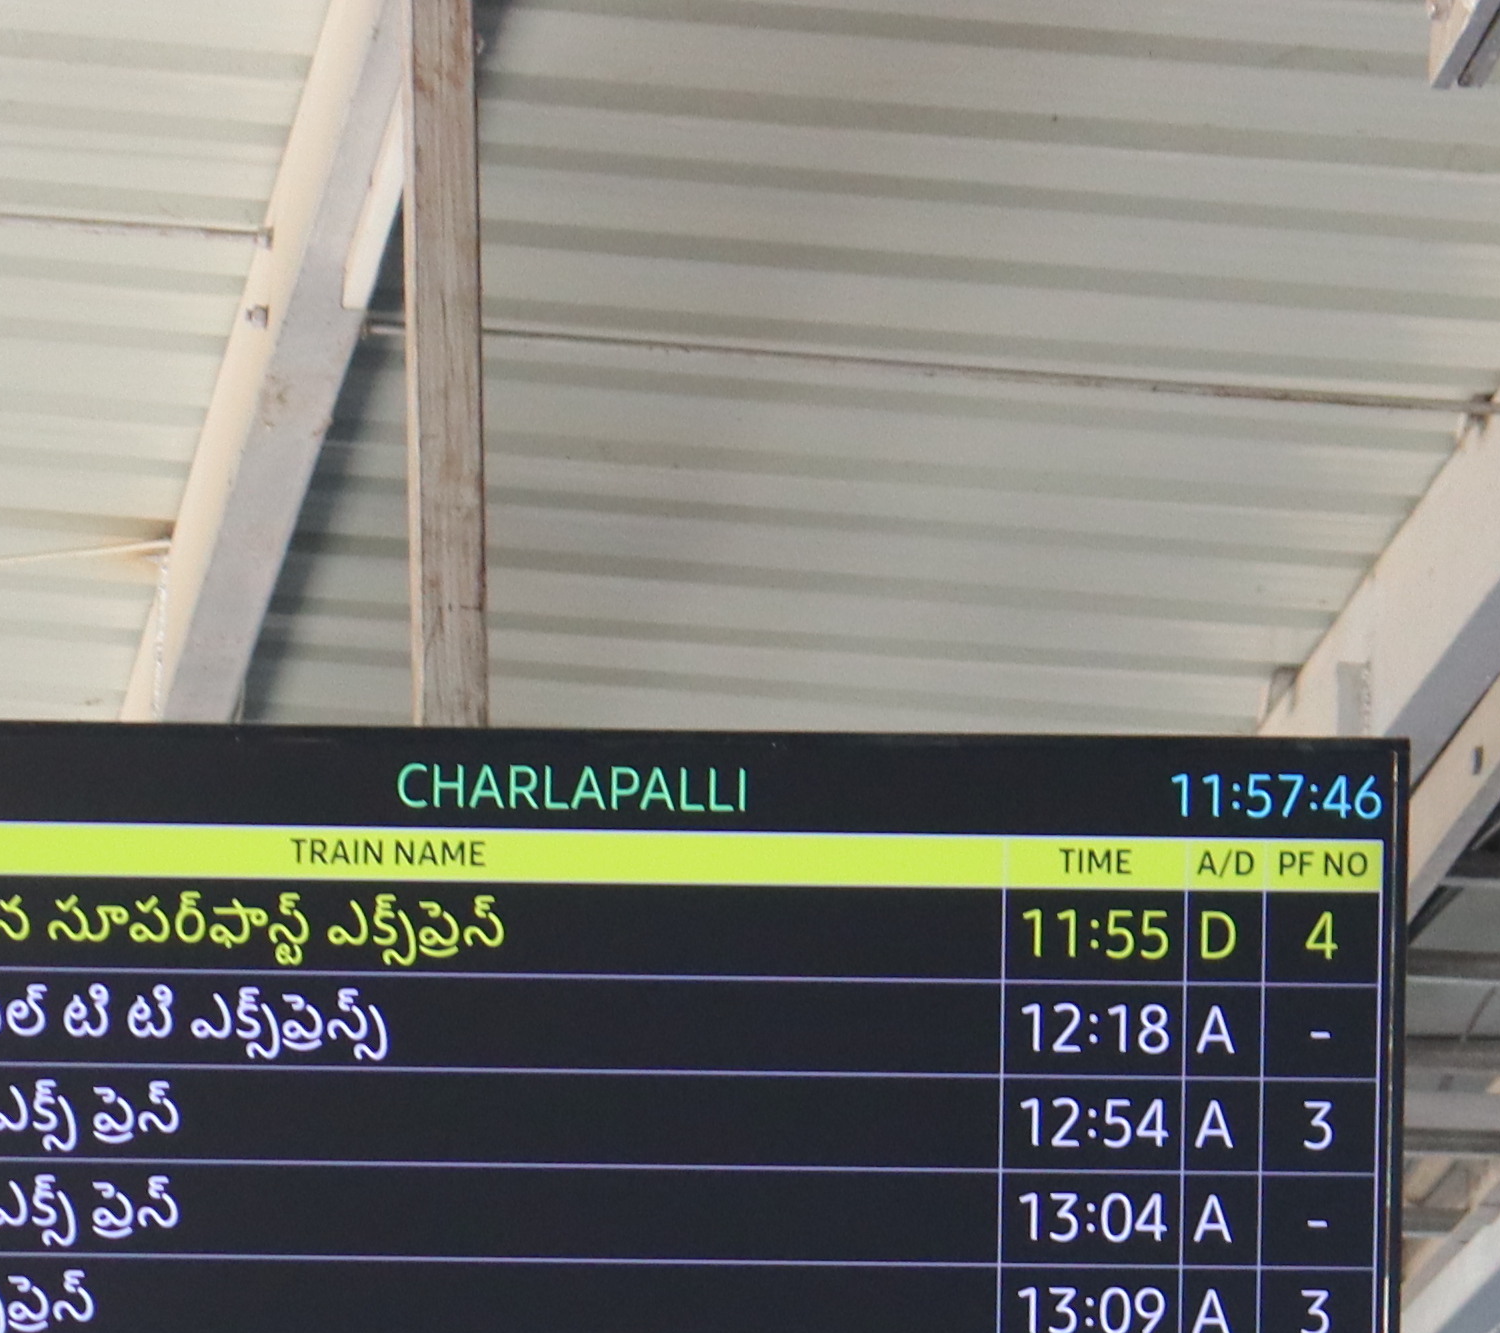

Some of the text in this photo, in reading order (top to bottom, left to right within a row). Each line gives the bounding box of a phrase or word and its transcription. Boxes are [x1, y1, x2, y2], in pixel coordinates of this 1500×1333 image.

[398, 764, 745, 811] CHARLAPALLI
[1172, 774, 1382, 819] 11:57:46
[292, 839, 484, 865] TRAIN NAME
[1060, 849, 1130, 874] TIME
[1198, 851, 1254, 876] A/D
[1280, 852, 1367, 876] PF NO
[1023, 909, 1168, 959] 11:55
[1201, 911, 1236, 959] D
[1306, 912, 1337, 959] 4
[64, 983, 109, 1037] టి
[128, 984, 173, 1038] టి
[1022, 1003, 1169, 1054] 12:18
[1197, 1006, 1234, 1053] A
[1021, 1097, 1169, 1148] 12:54
[1195, 1100, 1233, 1148] A
[1304, 1101, 1332, 1150] 3
[1020, 1193, 1167, 1242] 13:04
[1194, 1195, 1231, 1242] A
